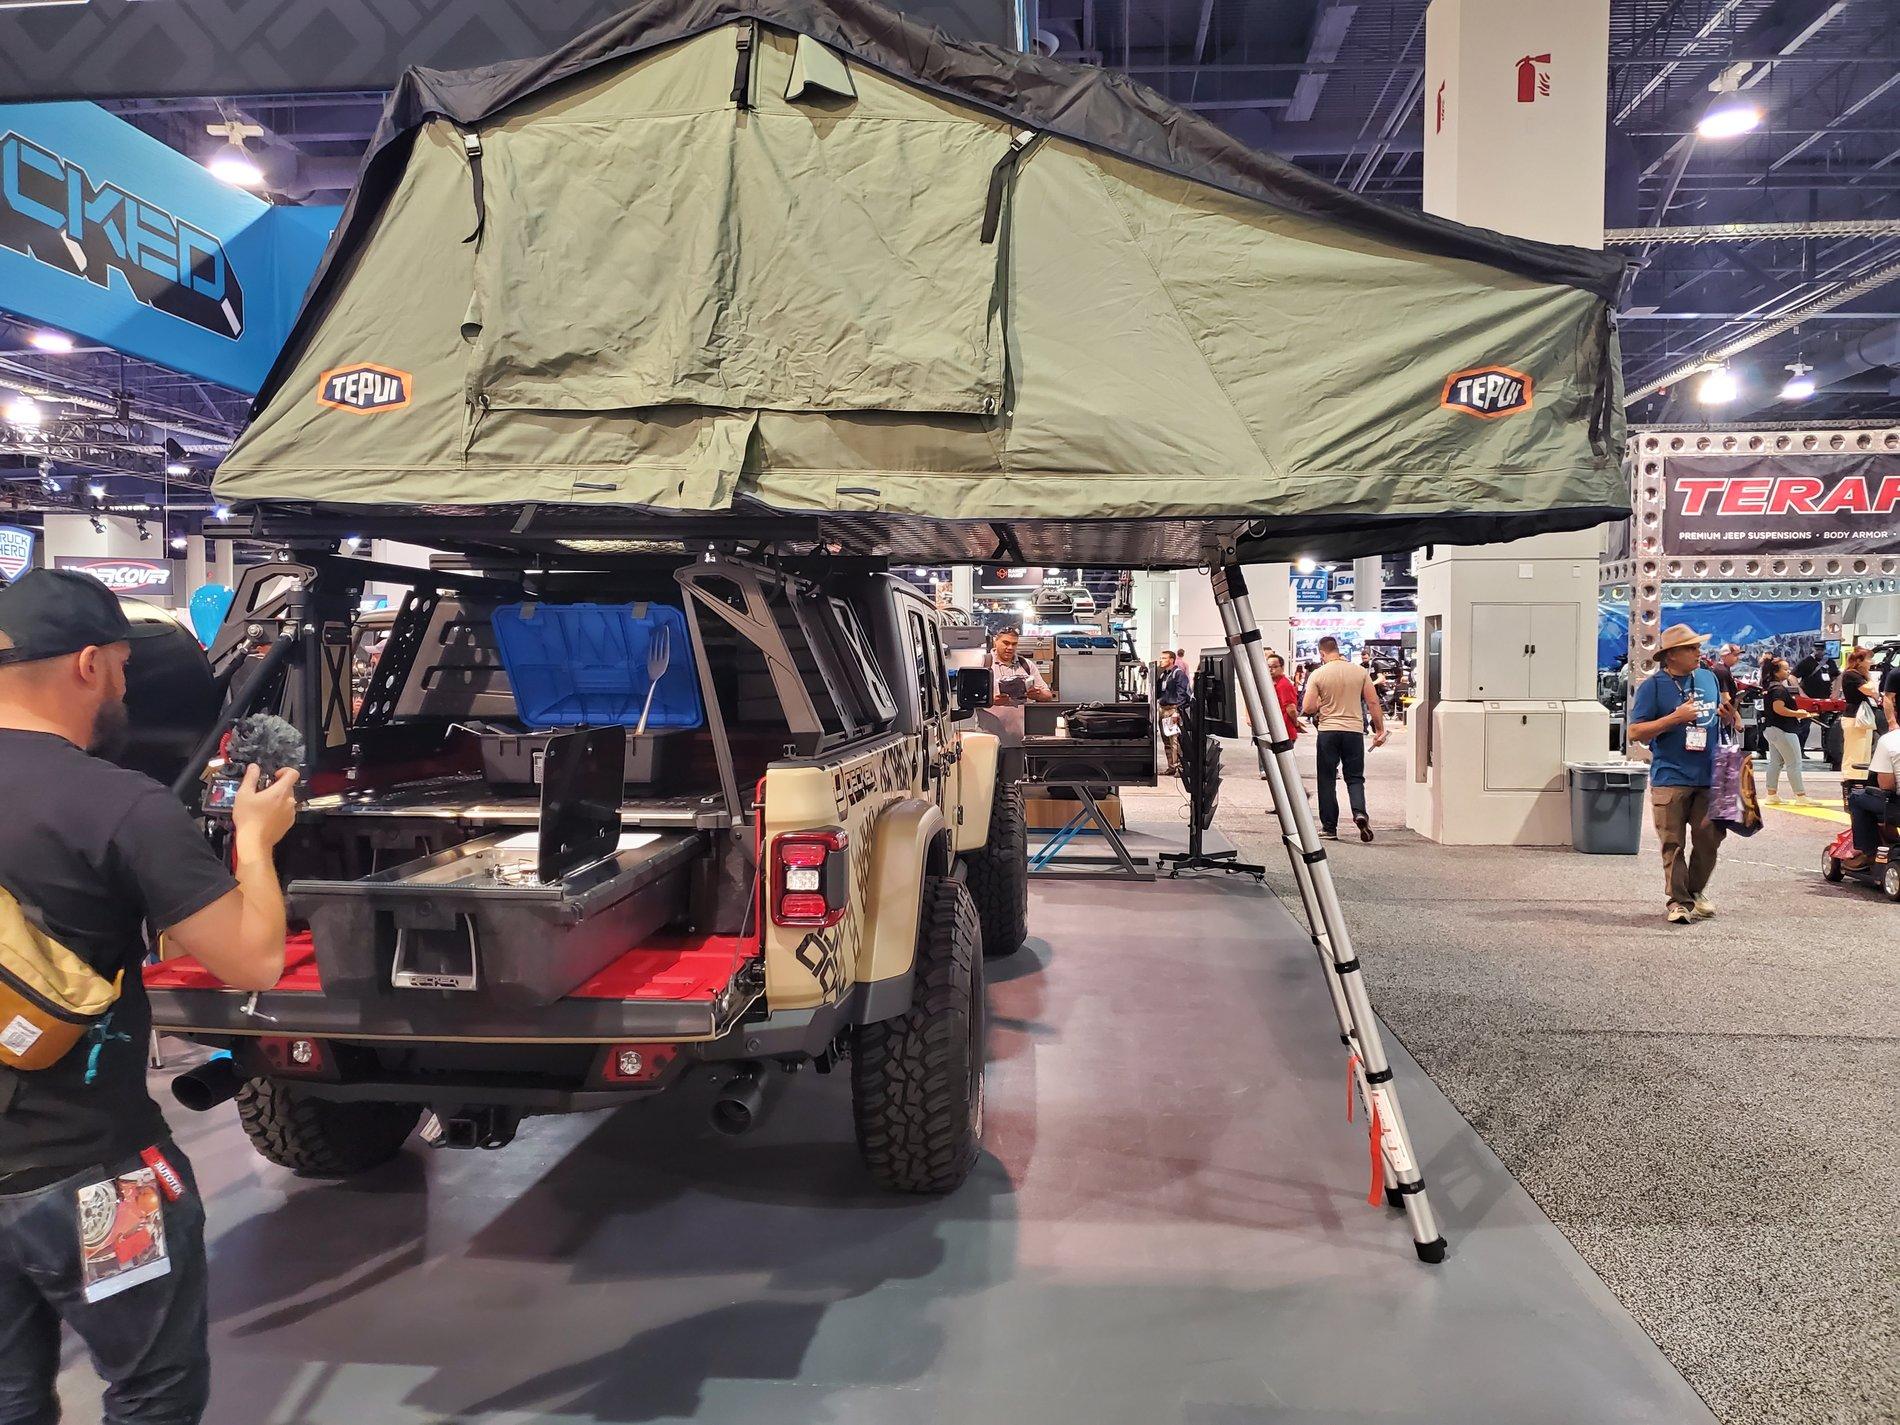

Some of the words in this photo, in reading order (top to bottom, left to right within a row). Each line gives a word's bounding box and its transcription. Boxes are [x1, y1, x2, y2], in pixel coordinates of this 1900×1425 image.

[332, 371, 398, 406] TEPUI
[1457, 374, 1522, 410] TEPUI
[1678, 531, 1721, 541] PREMIUM
[1722, 531, 1746, 540] JEEP
[1747, 531, 1812, 540] SUSPENSIONS
[1823, 531, 1850, 539] BODY
[1852, 530, 1889, 539] ARMOR
